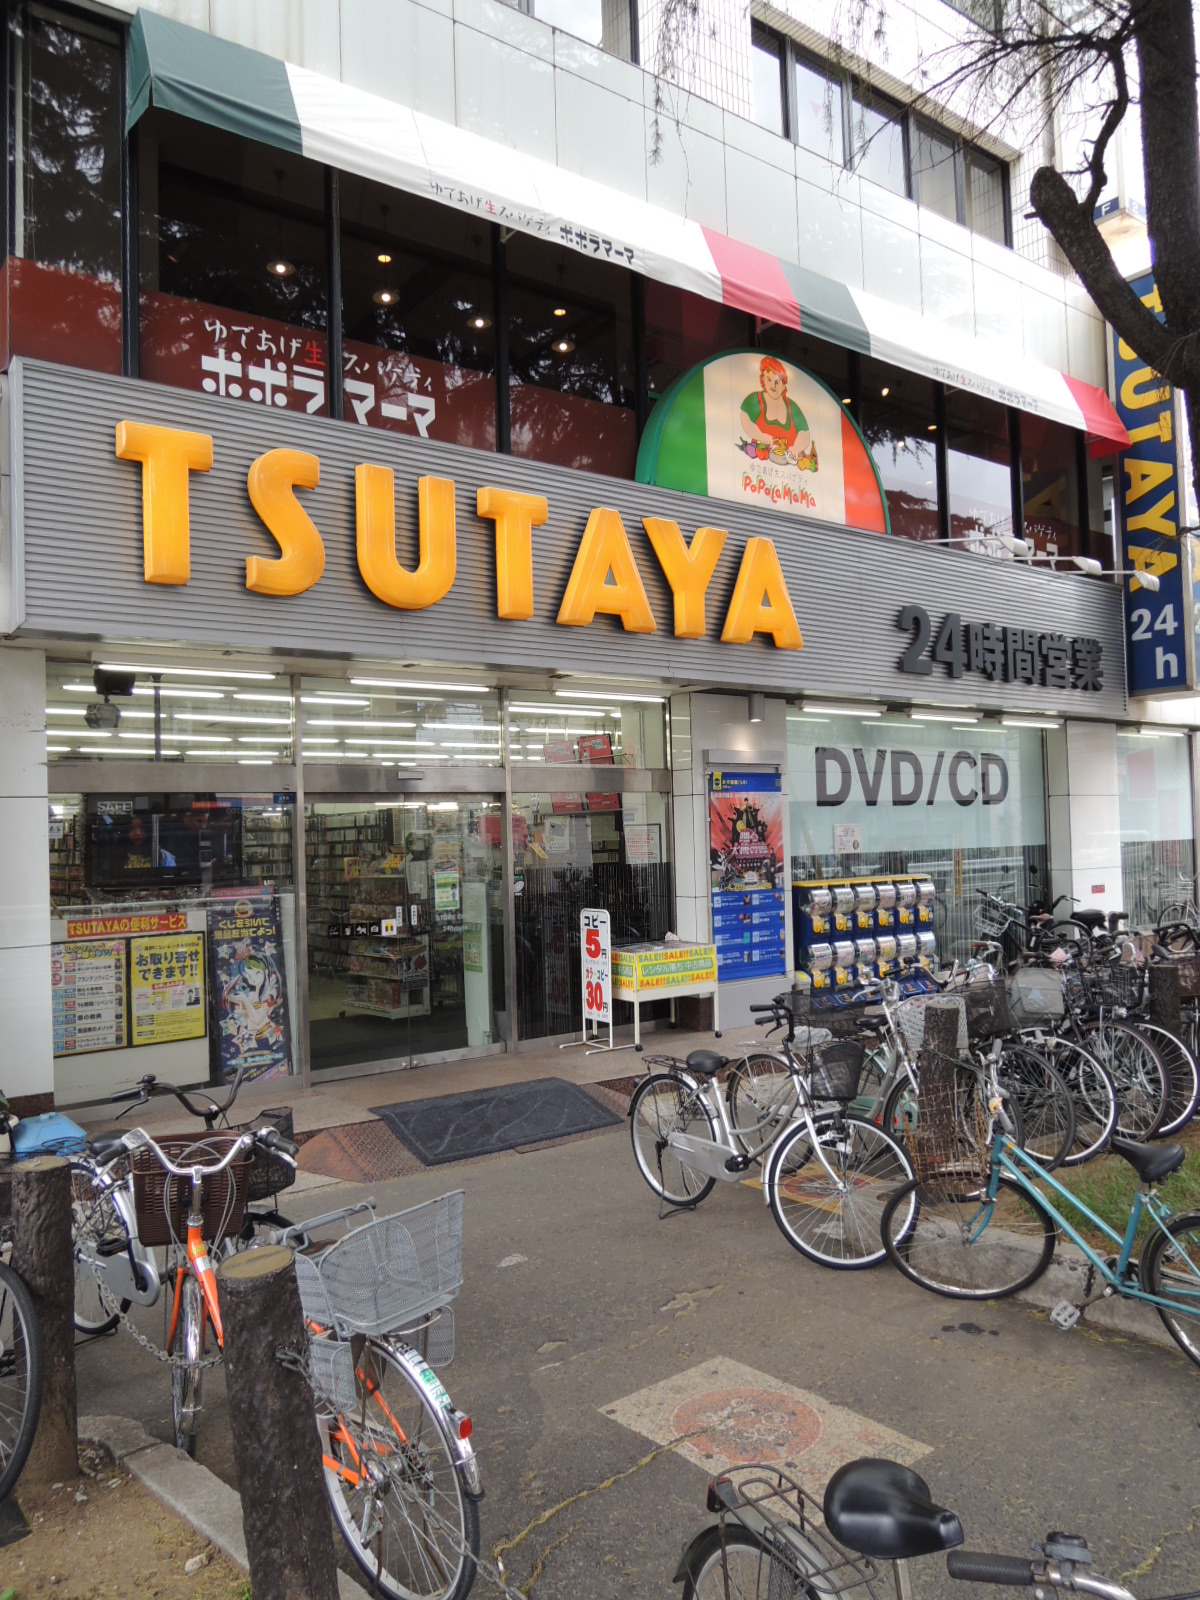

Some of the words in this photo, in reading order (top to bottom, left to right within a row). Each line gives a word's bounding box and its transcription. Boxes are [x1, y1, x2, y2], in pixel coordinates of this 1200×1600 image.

[560, 224, 635, 266] ポポラマーマ
[204, 318, 432, 393] ゆであげ生スパゲティ
[201, 347, 436, 438] ポポラマーマ
[115, 419, 803, 649] TSUTAYA
[1130, 603, 1178, 641] 24
[896, 605, 1104, 691] 24時間営業
[1155, 646, 1178, 680] h
[815, 746, 1009, 807] DVD/CD
[68, 914, 187, 935] TSUTAYAの便利サービス
[218, 917, 270, 929] くじを引いて
[584, 915, 606, 928] コピー
[135, 950, 200, 967] お取り寄せ
[585, 967, 608, 982] カラーコピー
[642, 963, 684, 976] レンタル落ち
